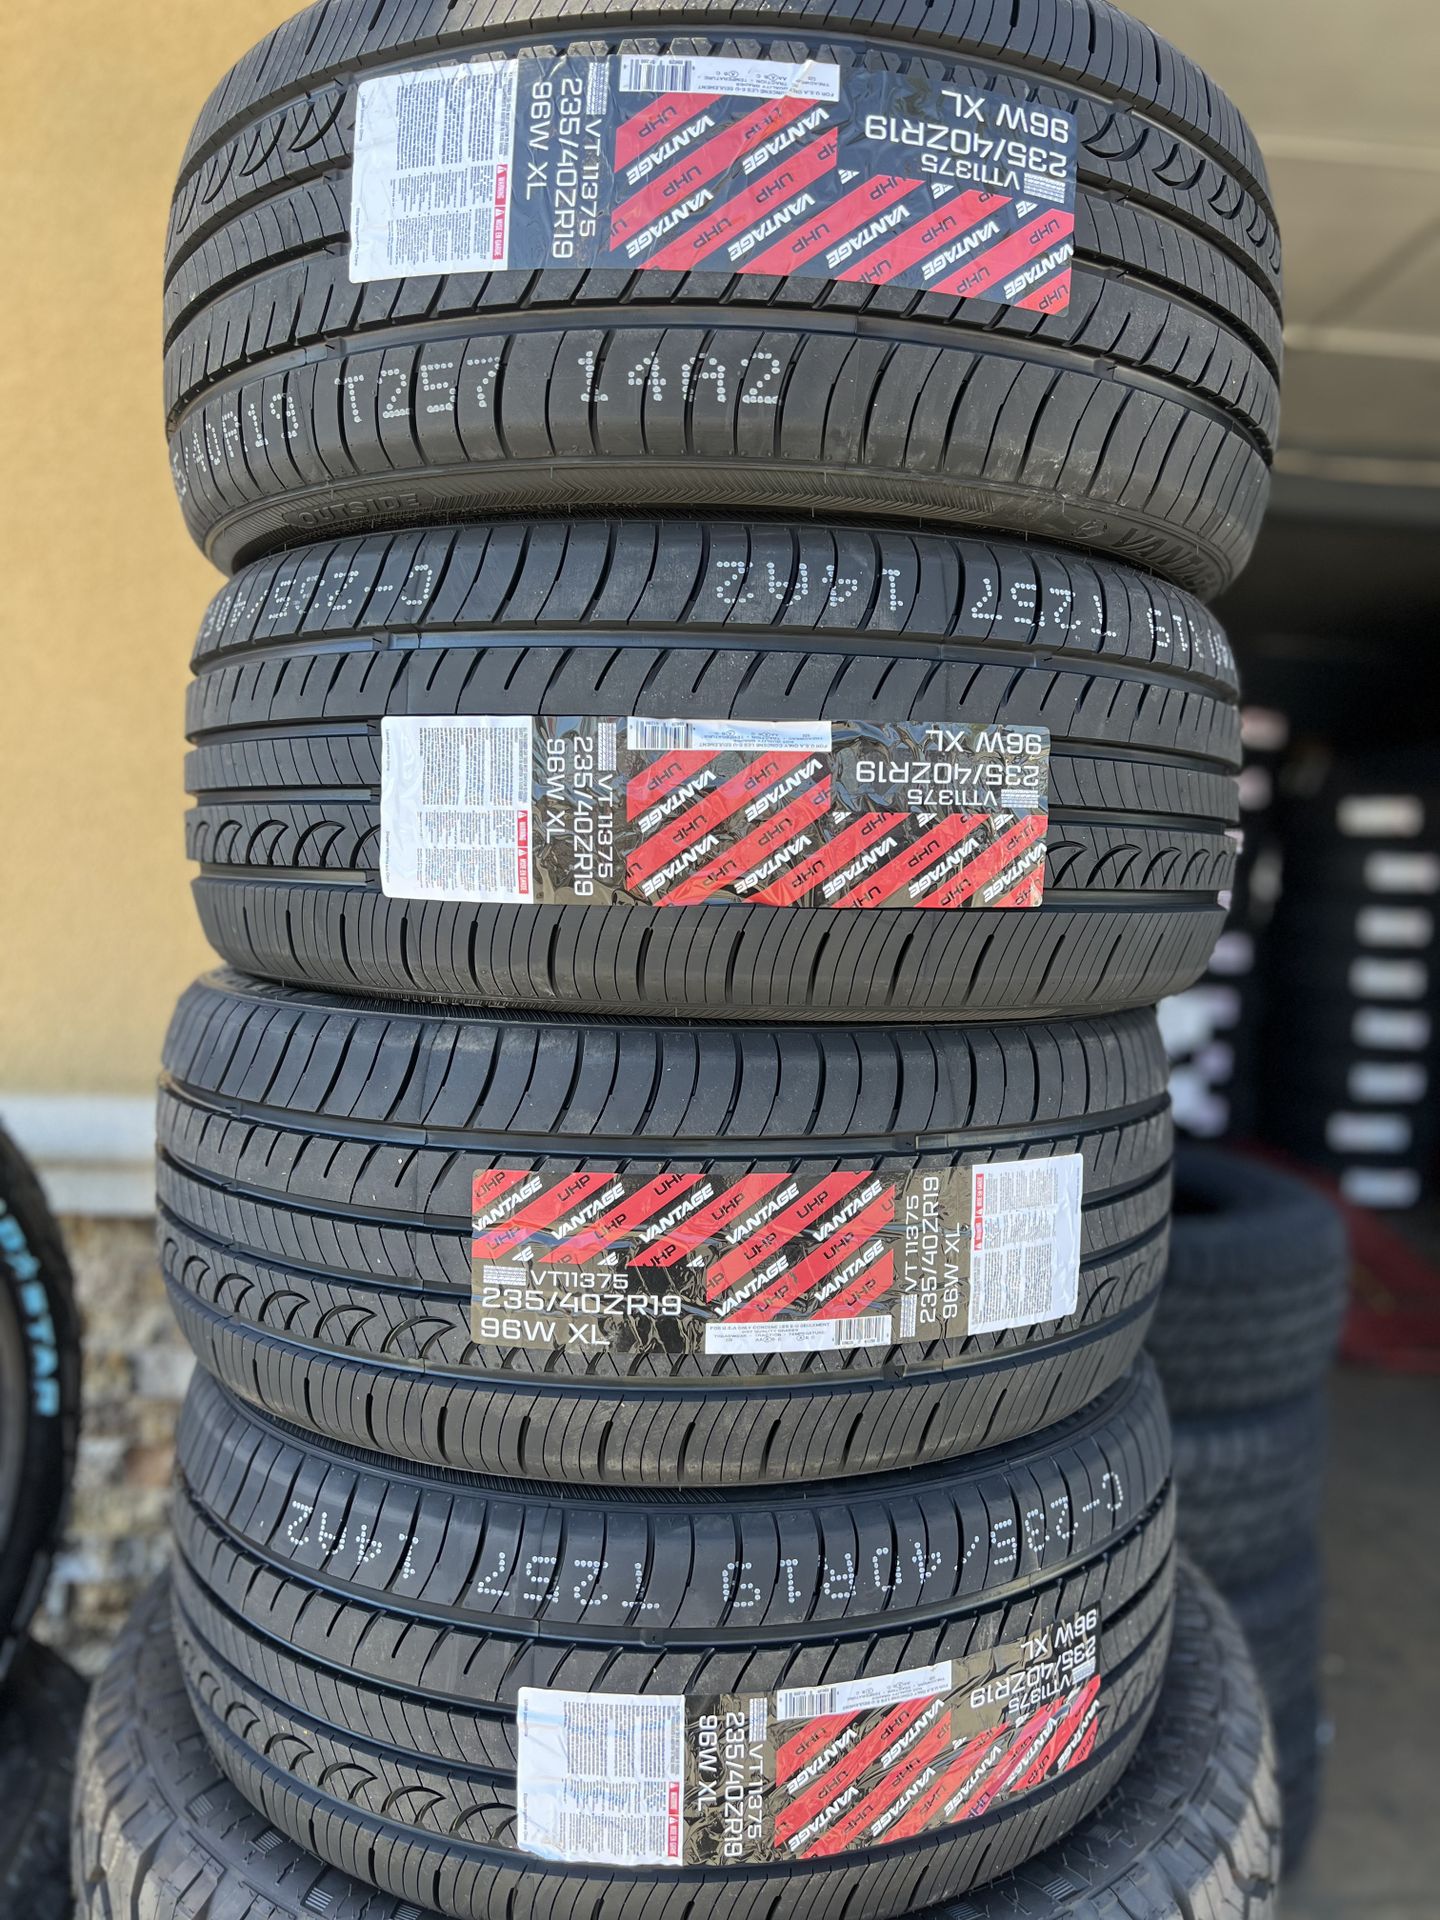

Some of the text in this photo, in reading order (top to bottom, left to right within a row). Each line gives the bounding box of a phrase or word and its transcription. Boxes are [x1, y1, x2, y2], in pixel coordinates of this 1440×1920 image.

[526, 81, 553, 200] 96W XL
[638, 106, 678, 138] UHP
[742, 108, 830, 175] VANTAGE
[941, 90, 1070, 144] 96W XL
[552, 77, 583, 260] 235/40ZR19
[626, 115, 716, 186] VANTAGE
[864, 114, 1067, 178] 235/40ZR19
[922, 153, 1020, 191] VT11375
[579, 118, 602, 238] VT11375
[662, 166, 702, 198] UHP
[756, 172, 794, 204] UHP
[626, 188, 714, 259] VANTAGE
[693, 218, 732, 247] UHP
[728, 193, 815, 262] VANTAGE
[791, 223, 830, 254] UHP
[826, 204, 911, 269] VANTAGE
[921, 216, 956, 244] UHP
[922, 220, 1000, 281] VANTAGE
[1029, 218, 1060, 246] UHP
[956, 266, 990, 294] UHP
[1004, 242, 1074, 300] VANTAGE
[1038, 284, 1069, 311] UHP
[334, 356, 500, 423] T257
[578, 350, 782, 404] 14A2
[300, 492, 420, 528] OUTSIDE
[926, 730, 1042, 754] 96W XL
[546, 739, 566, 844] 96W XL
[648, 762, 682, 792] UHP
[744, 762, 780, 792] UHP
[745, 758, 824, 822] VANTAGE
[856, 760, 1040, 786] 235/40ZR19
[908, 789, 998, 806] VT11375
[573, 736, 594, 896] 235/40ZR19
[598, 774, 617, 878] VT11375
[638, 770, 716, 833] VANTAGE
[672, 814, 708, 844] UHP
[758, 818, 792, 848] UHP
[908, 840, 940, 868] UHP
[642, 834, 720, 898] VANTAGE
[702, 860, 738, 887] UHP
[734, 835, 812, 894] VANTAGE
[791, 860, 826, 889] UHP
[822, 836, 898, 899] VANTAGE
[908, 838, 978, 899] VANTAGE
[940, 879, 972, 906] UHP
[983, 842, 1048, 903] VANTAGE
[472, 1176, 543, 1232] VANTAGE
[550, 1183, 626, 1240] VANTAGE
[557, 1175, 592, 1202] UHP
[638, 1184, 714, 1243] VANTAGE
[711, 1192, 745, 1221] UHP
[726, 1182, 800, 1245] VANTAGE
[796, 1190, 829, 1220] UHP
[812, 1179, 883, 1243] VANTAGE
[486, 1225, 521, 1250] UHP
[594, 1213, 627, 1240] UHP
[744, 1232, 778, 1260] UHP
[823, 1230, 855, 1260] UHP
[905, 1194, 919, 1292] VT11375
[920, 1176, 940, 1322] 235/40ZR19
[531, 1270, 629, 1290] VT11375
[714, 1256, 790, 1317] VANTAGE
[756, 1284, 790, 1312] UHP
[814, 1240, 884, 1302] VANTAGE
[846, 1278, 876, 1306] UHP
[944, 1222, 961, 1319] 96W XL
[480, 1288, 682, 1316] 235/40ZR19
[480, 1317, 611, 1346] 96W XL
[288, 1502, 418, 1578] 14A2
[478, 1552, 660, 1609] T257
[1021, 1608, 1097, 1660] 96W XL
[970, 1635, 1096, 1708] 235/40ZR19
[1009, 1674, 1071, 1714] VT11375
[796, 1728, 827, 1756] UHP
[880, 1711, 910, 1740] UHP
[880, 1699, 944, 1768] VANTAGE
[1057, 1700, 1100, 1770] VANTAGE
[698, 1714, 718, 1812] 96W XL
[724, 1712, 744, 1857] 235/40ZR19
[786, 1728, 858, 1795] VANTAGE
[817, 1770, 849, 1799] UHP
[892, 1757, 921, 1788] UHP
[944, 1746, 1001, 1816] VANTAGE
[1028, 1755, 1049, 1784] UHP
[748, 1744, 764, 1838] VT11375
[788, 1787, 860, 1851] VANTAGE
[844, 1804, 874, 1834] UHP
[870, 1767, 936, 1837] VANTAGE
